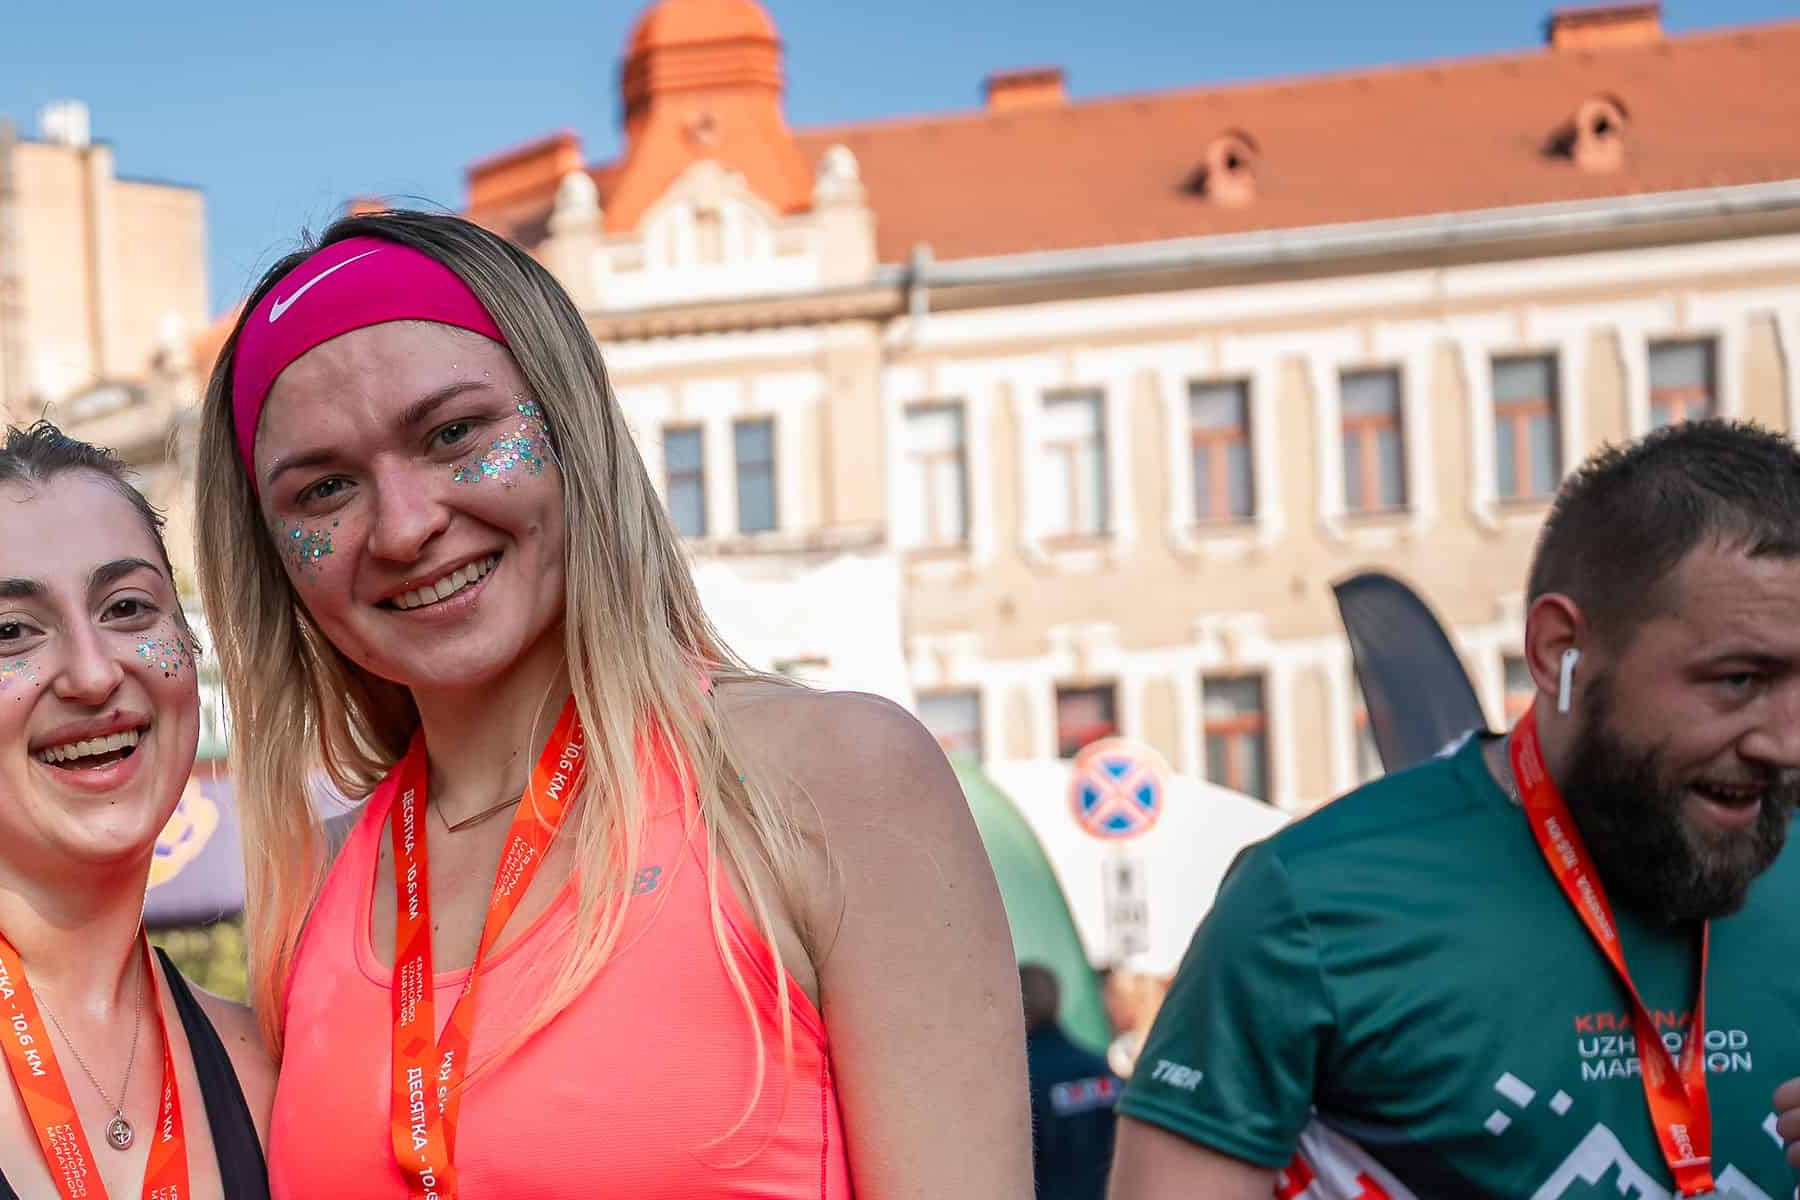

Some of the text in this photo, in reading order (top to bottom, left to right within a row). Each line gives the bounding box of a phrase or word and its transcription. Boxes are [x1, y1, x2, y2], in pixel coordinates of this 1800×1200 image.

[1575, 1010, 1692, 1033] KRANA
[1578, 1029, 1748, 1058] UZHOOD
[11, 1013, 34, 1047] 10,6
[24, 1049, 46, 1077] КМ
[407, 1067, 428, 1151] ДЕСЯТКА
